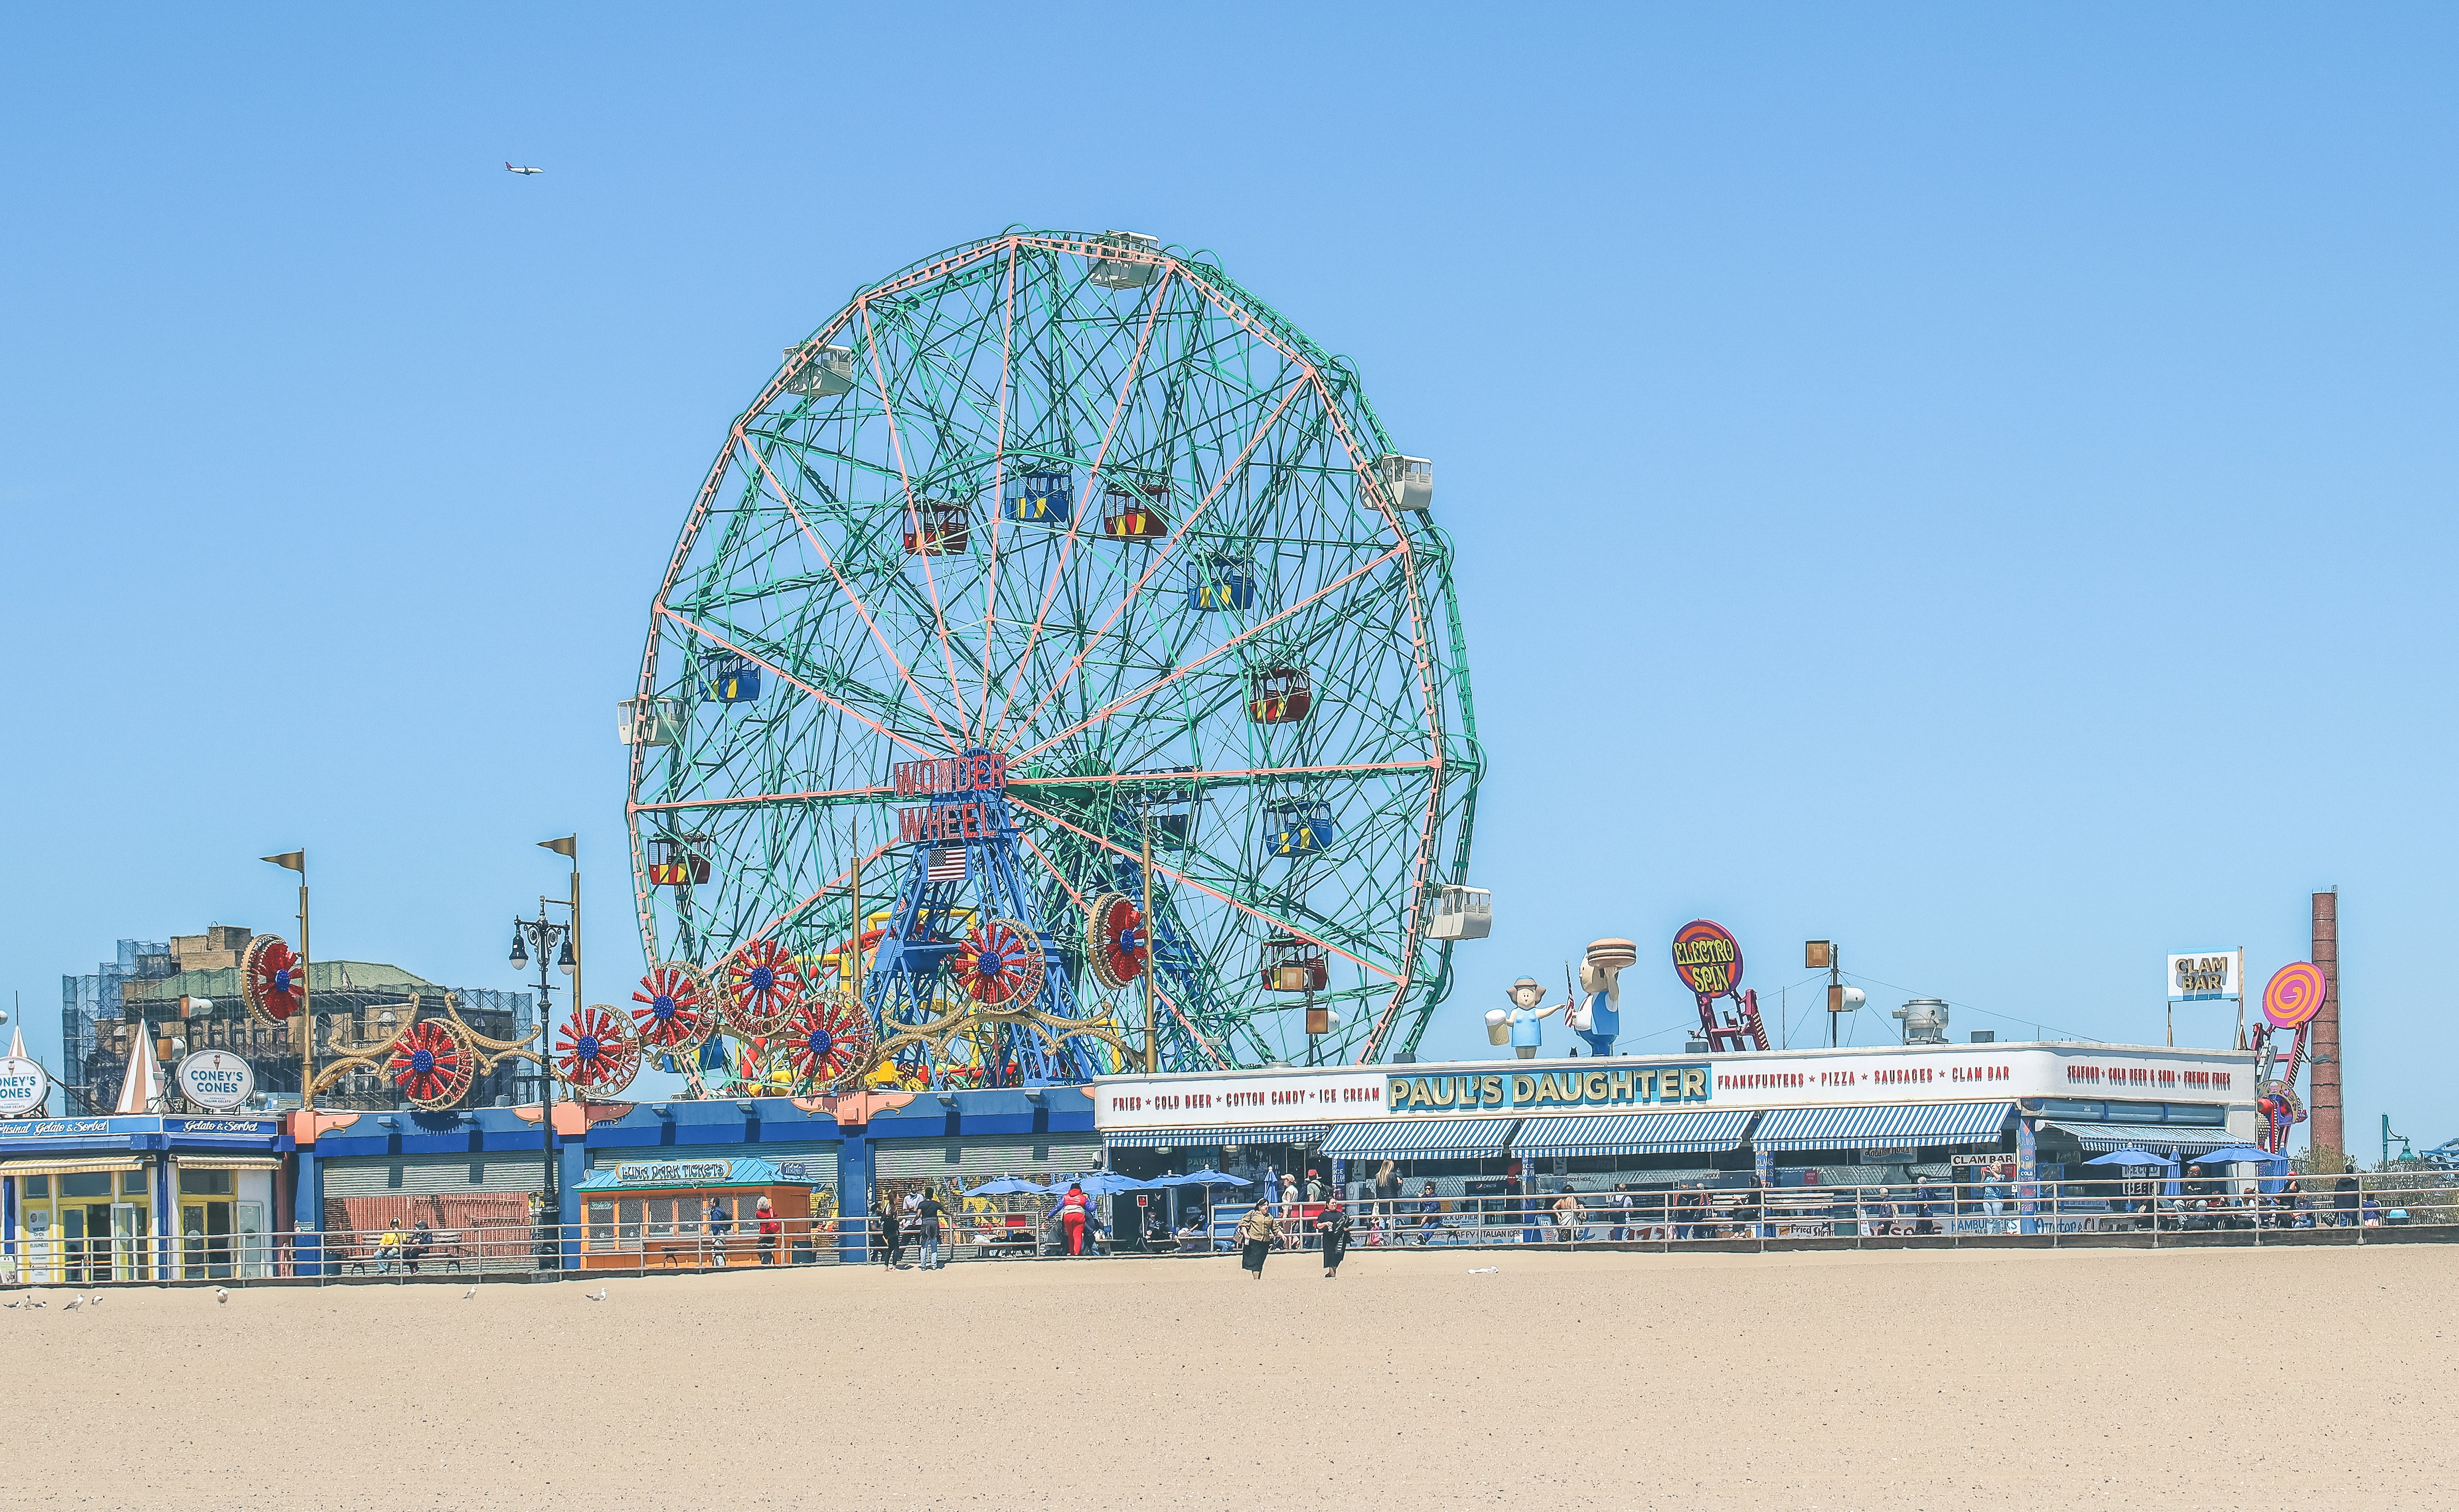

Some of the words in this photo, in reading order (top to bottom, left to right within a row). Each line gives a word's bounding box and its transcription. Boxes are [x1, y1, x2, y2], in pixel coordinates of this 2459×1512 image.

[894, 754, 1006, 796] WONDER
[898, 802, 997, 842] WHEEL
[1674, 939, 1734, 964] ELECTRO
[2175, 957, 2228, 973] CLAM
[1692, 965, 1729, 992] SPIN
[2182, 975, 2223, 990] BAR
[191, 1070, 243, 1082] CONEY'S
[1718, 1073, 1804, 1089] FRANKFURTERS
[1821, 1071, 1855, 1086] PIZZA
[1875, 1068, 1932, 1085] SAUSAGES
[1953, 1067, 1982, 1082] CLAM
[1988, 1066, 2009, 1081] BAR
[2109, 1067, 2126, 1081] COLD
[2129, 1068, 2147, 1082] BEER
[2212, 1072, 2230, 1086] FRIES
[197, 1082, 238, 1093] CONES
[1389, 1075, 1503, 1106] PAUL'S
[1512, 1068, 1707, 1102] DAUGHTER
[1113, 1096, 1141, 1111] FRIES
[1155, 1096, 1179, 1110] COLD
[1186, 1094, 1211, 1108] BEER
[1227, 1092, 1265, 1107] COTTON
[1272, 1090, 1306, 1104] CANDY
[1320, 1089, 1336, 1103] ICE
[1344, 1087, 1379, 1102] CREAM
[34, 1121, 65, 1135] Gelato
[74, 1120, 107, 1132] Sorbet
[183, 1120, 216, 1132] Gelato
[224, 1121, 258, 1132] Sorbet
[1953, 1156, 1986, 1164] CLAM
[1989, 1155, 2013, 1163] BAR
[622, 1166, 650, 1179] LUNA
[652, 1165, 681, 1179] PARK
[682, 1163, 724, 1177] TICKETS
[1791, 1224, 1811, 1234] Fried
